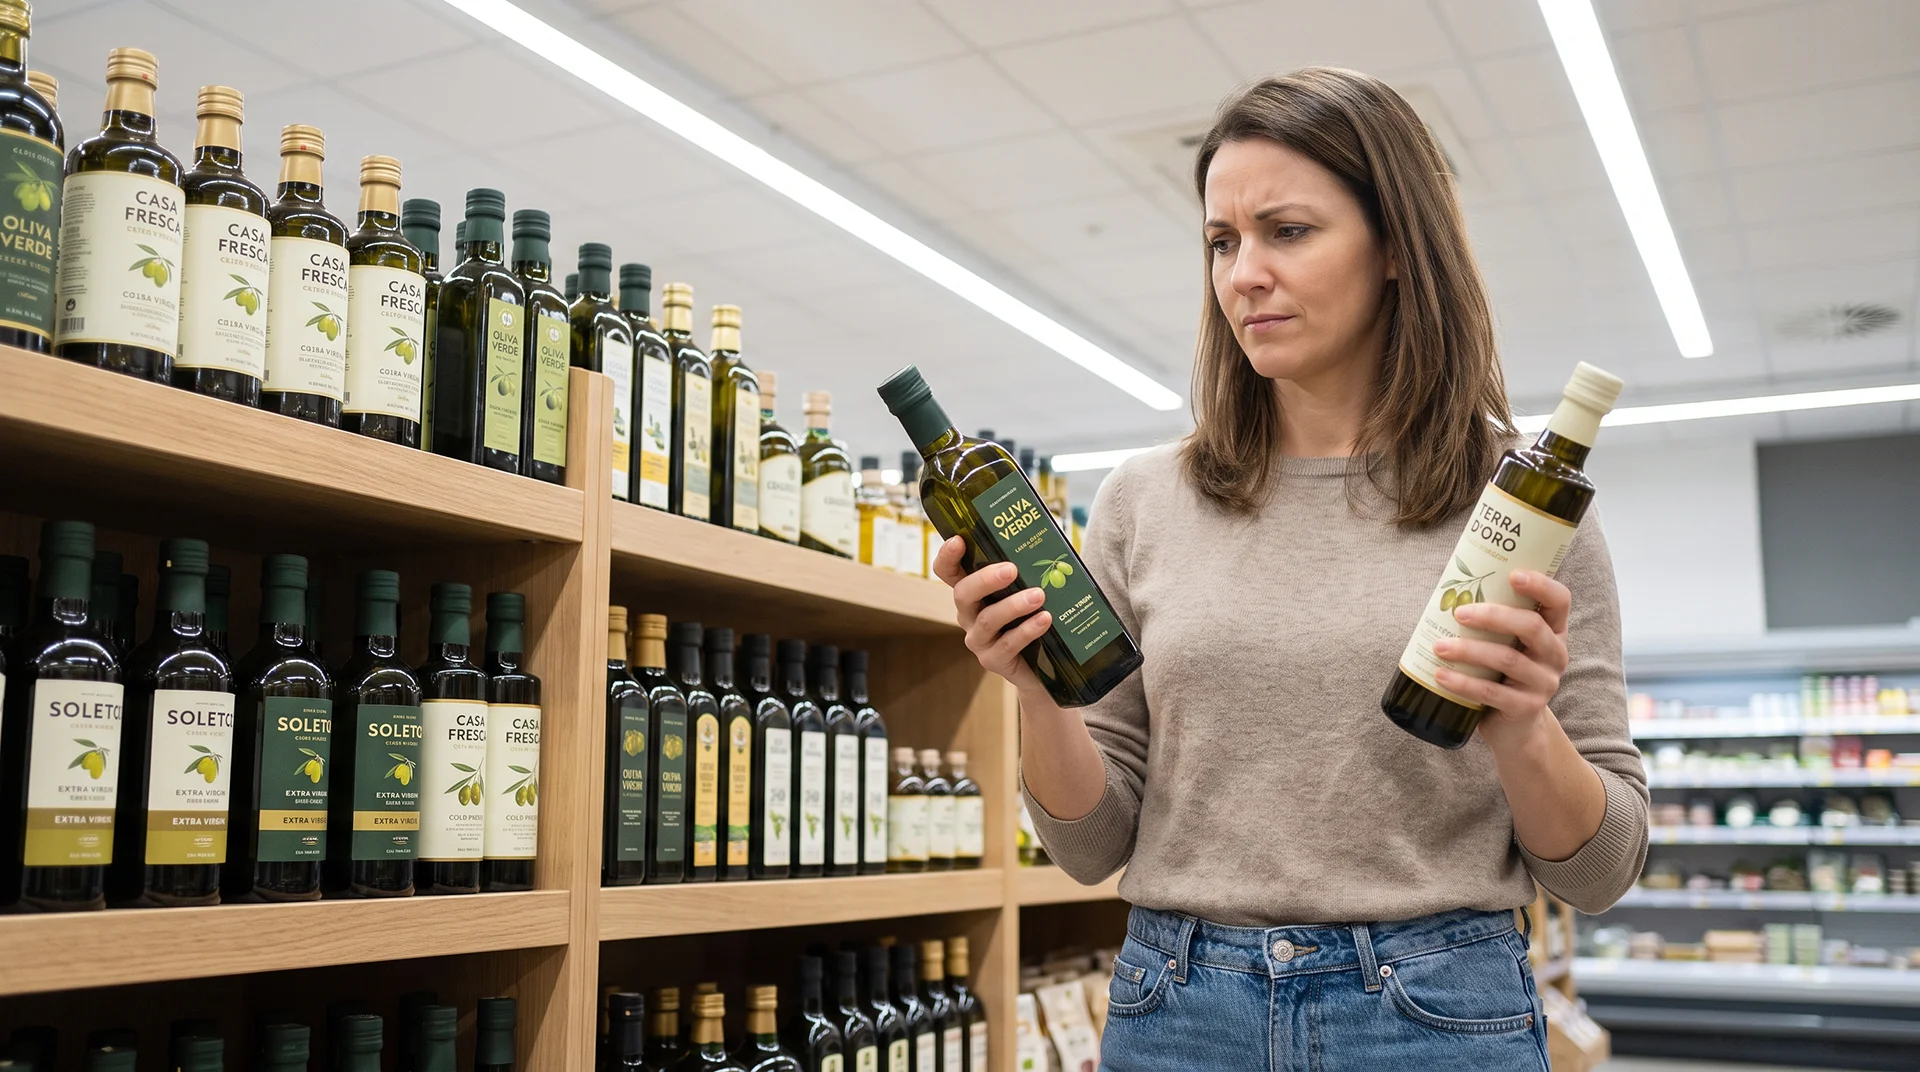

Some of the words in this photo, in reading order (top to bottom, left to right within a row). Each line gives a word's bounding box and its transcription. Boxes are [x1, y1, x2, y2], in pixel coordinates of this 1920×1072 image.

[135, 190, 178, 215] CASA
[3, 215, 52, 242] OLIVA
[125, 206, 181, 236] FRESCA
[228, 223, 266, 247] CASA
[0, 231, 52, 260] VERDE
[218, 238, 268, 266] FRESCA
[310, 253, 346, 275] CASA
[301, 268, 348, 292] FRESCA
[388, 280, 422, 299] CASA
[492, 330, 519, 346] OLIVA
[491, 340, 519, 357] VERDE
[541, 345, 565, 361] OLIVA
[540, 355, 565, 371] VERDE
[993, 498, 1032, 528] OLIVA
[1478, 503, 1521, 537] TERRA
[999, 507, 1041, 540] VERDE
[1470, 518, 1517, 552] D'ORO
[277, 716, 331, 734] SOLETO
[456, 714, 485, 727] CASA
[512, 718, 539, 730] CASA
[367, 722, 423, 739] SOLETO
[505, 731, 540, 744] FRESC
[58, 785, 89, 793] EXTRA
[175, 789, 204, 797] EXTRA
[285, 789, 310, 797] EXTRA
[375, 791, 401, 799] EXTRA
[54, 815, 87, 825] EXTRA
[282, 816, 309, 824] EXTRA
[373, 817, 399, 825] EXTRA
